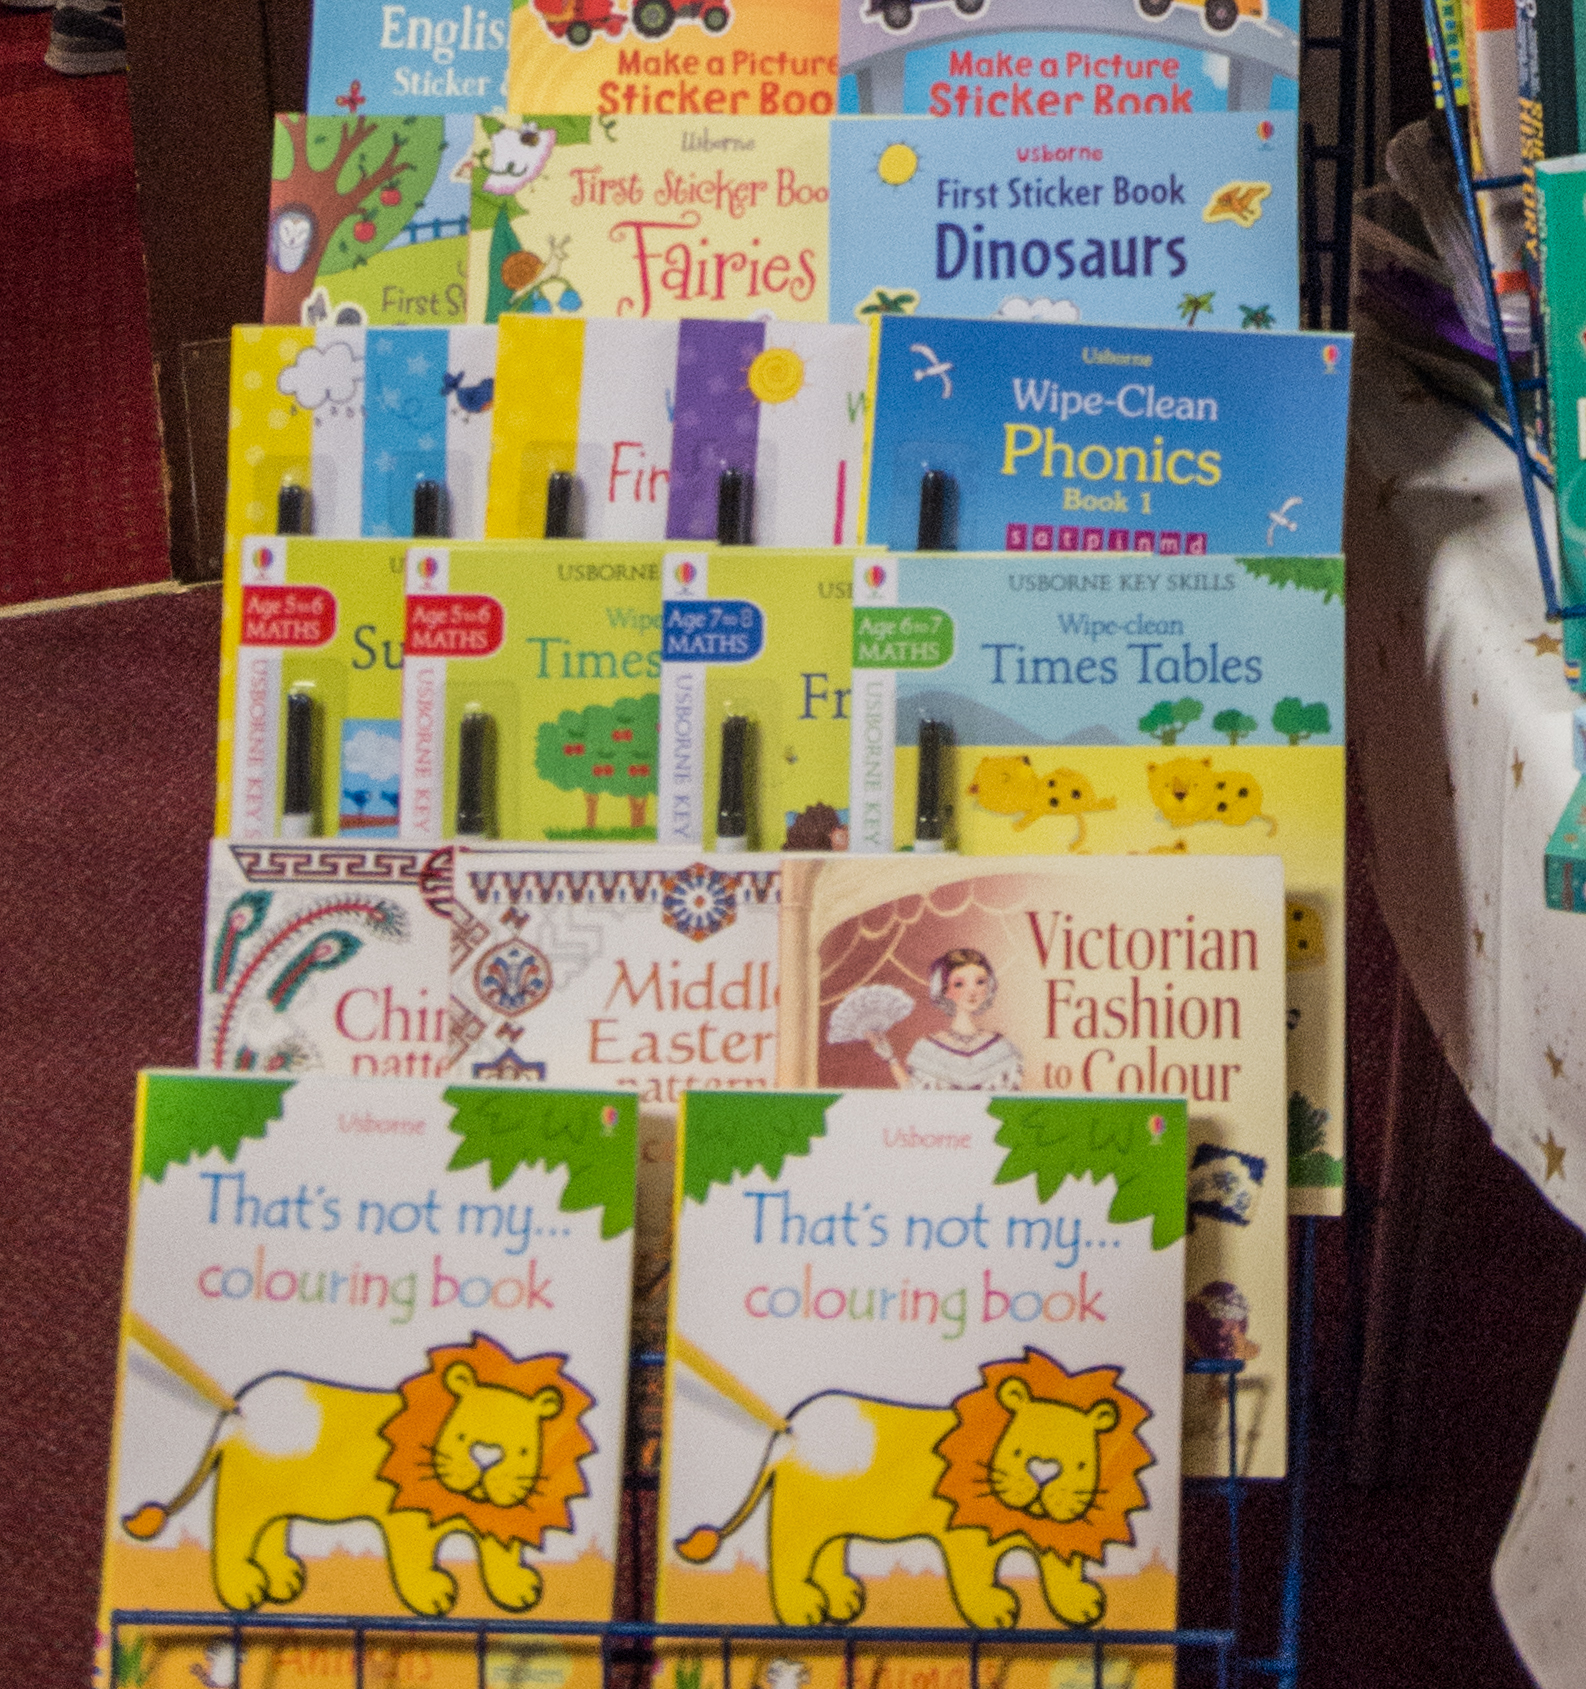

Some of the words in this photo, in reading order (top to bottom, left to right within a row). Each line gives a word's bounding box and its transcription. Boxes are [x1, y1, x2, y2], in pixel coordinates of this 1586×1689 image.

[948, 51, 1030, 82] Make
[1036, 59, 1059, 82] a
[1067, 51, 1180, 82] Picture
[930, 82, 1079, 116] Sticker
[1086, 82, 1195, 116] Book
[936, 177, 998, 209] First
[1006, 174, 1110, 209] Sticker
[1118, 173, 1187, 207] Book
[608, 218, 816, 318] Fairies
[934, 222, 1188, 282] Dinosaurs
[1012, 376, 1219, 424] Wipe-Clean
[1001, 422, 1222, 488] Phonics
[1008, 574, 1110, 595] USBORNE
[1118, 574, 1163, 594] KEY
[1169, 572, 1236, 594] SKILLS
[245, 616, 321, 641] MATHS
[412, 627, 489, 650] MATHS
[667, 633, 749, 655] MATHS
[858, 642, 941, 661] MATHS
[982, 642, 1120, 685] Times
[1127, 642, 1265, 686] Tables
[1025, 909, 1260, 973] Victorian
[1044, 979, 1243, 1040] Fashion
[1043, 1058, 1071, 1090] to
[1083, 1048, 1243, 1102] Colour
[338, 1113, 427, 1138] Usborne
[882, 1126, 973, 1151] Usborne
[200, 1171, 340, 1235] That's
[356, 1188, 443, 1236] not
[462, 1196, 573, 1254] my...
[744, 1189, 888, 1250] That's
[904, 1205, 990, 1251] not
[1006, 1209, 1121, 1266] my...
[197, 1260, 418, 1324] colouring
[432, 1257, 555, 1310] book
[744, 1278, 968, 1341] colouring
[983, 1273, 1107, 1326] book
